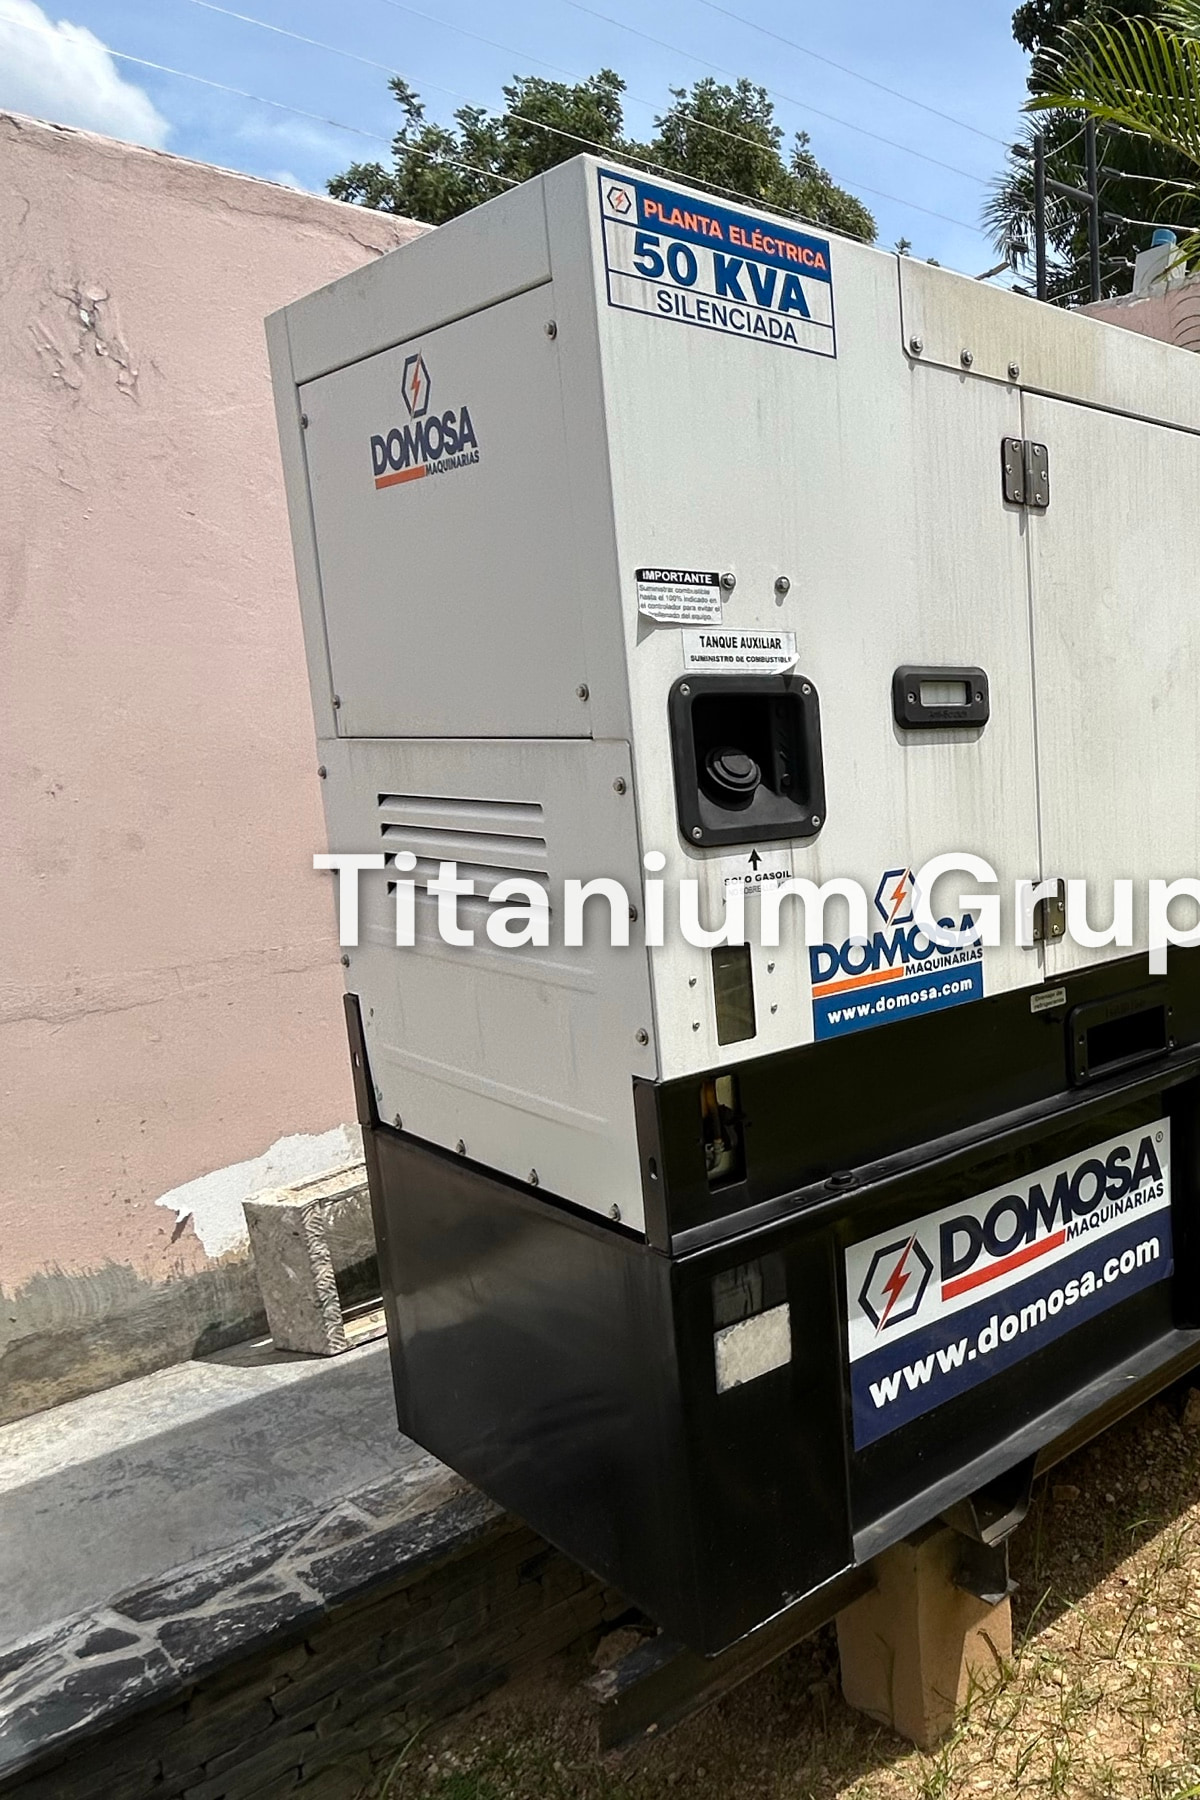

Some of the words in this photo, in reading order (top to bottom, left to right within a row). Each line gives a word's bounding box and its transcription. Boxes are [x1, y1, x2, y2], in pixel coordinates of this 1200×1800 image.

[643, 199, 724, 241] PLANTA
[729, 224, 827, 271] ELÉCTRICA
[633, 231, 698, 287] 50
[713, 252, 811, 319] KVA
[656, 290, 798, 344] SILENCIADA
[370, 405, 478, 476] DOMOSA
[425, 450, 480, 476] MAQUINARIAS
[642, 570, 713, 584] IMPORTANTE
[690, 654, 734, 663] SUMINISTRO
[735, 655, 745, 663] DE
[699, 635, 738, 649] TANQUE
[740, 636, 782, 650] AUXILIAR
[754, 870, 792, 882] GASOIL
[809, 914, 983, 985] DOMOSA
[904, 947, 984, 977] MAQUINARIAS
[827, 977, 973, 1025] www.domosa.com
[939, 1135, 1163, 1283] DOMOSA
[1065, 1181, 1165, 1243] MAQUINARIAS
[868, 1236, 1160, 1409] www.domosa.com
